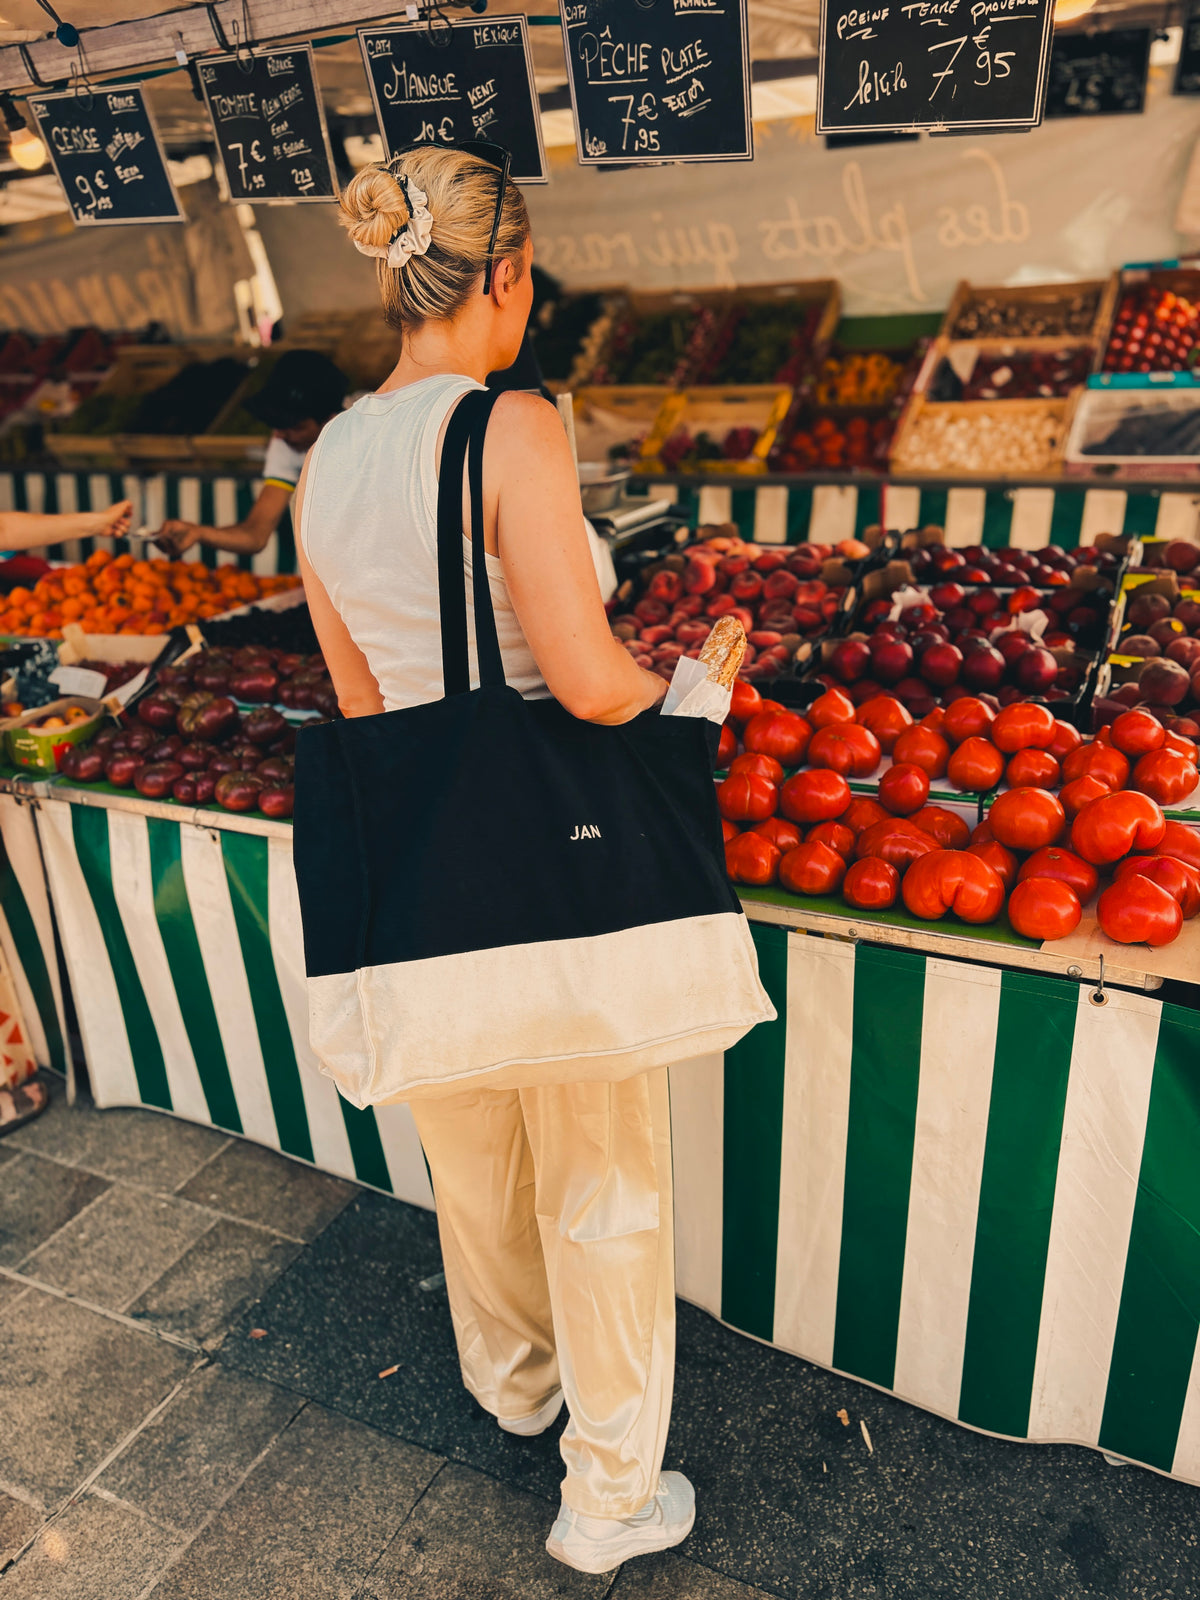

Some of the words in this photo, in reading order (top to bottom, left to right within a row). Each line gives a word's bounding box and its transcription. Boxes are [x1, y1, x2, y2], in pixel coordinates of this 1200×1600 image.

[901, 0, 960, 20] TERRE
[473, 25, 519, 45] MEXiQUE
[579, 25, 652, 79] PÊCHE
[661, 39, 709, 75] PLATE
[383, 60, 459, 99] MANGUE
[467, 79, 496, 105] KENT
[210, 93, 258, 117] TOMATE
[570, 824, 602, 841] JAN
